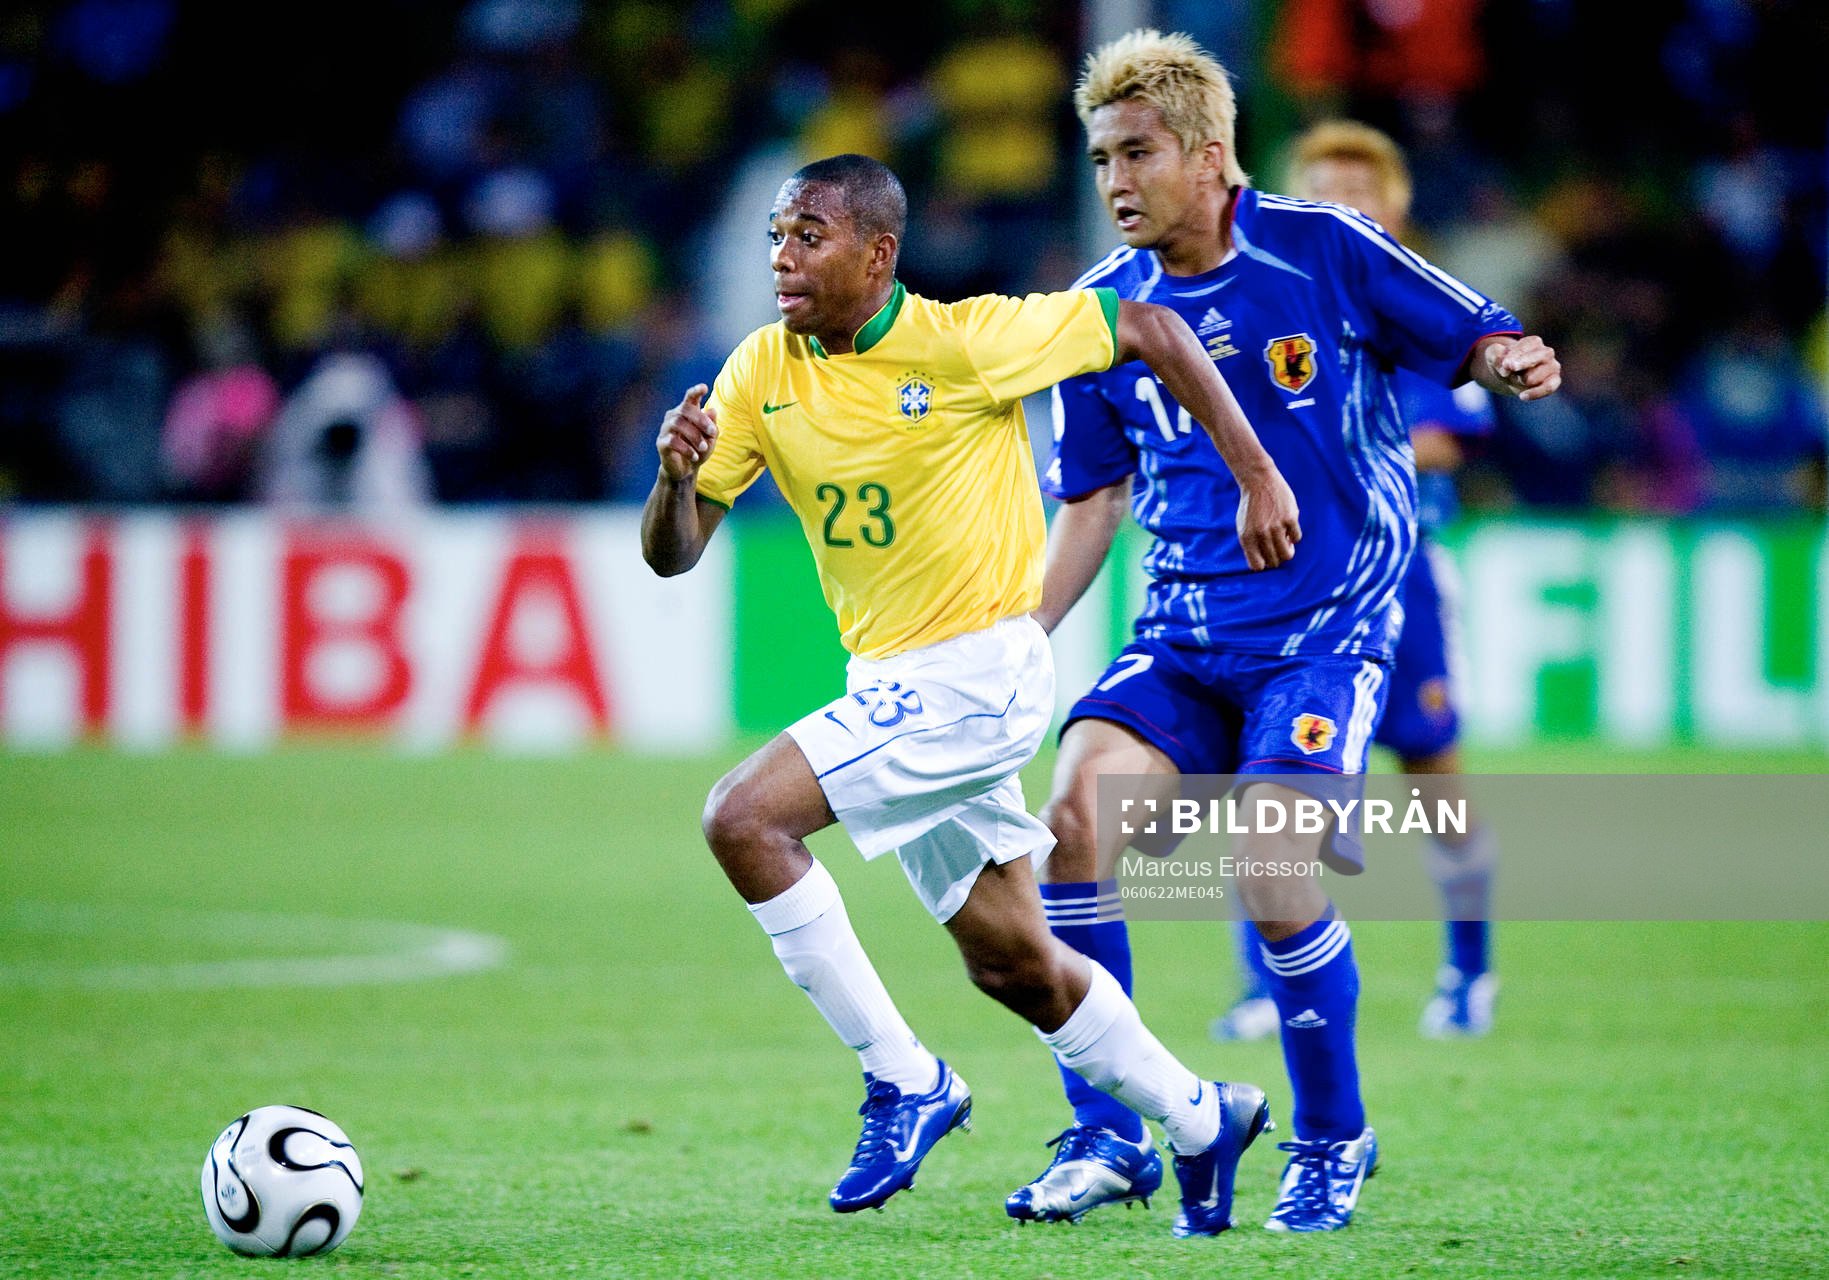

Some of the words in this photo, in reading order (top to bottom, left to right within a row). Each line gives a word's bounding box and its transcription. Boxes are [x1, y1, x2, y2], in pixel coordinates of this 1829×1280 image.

[815, 481, 896, 548] 23
[0, 527, 611, 734] HIBA
[1468, 525, 1829, 742] FIL
